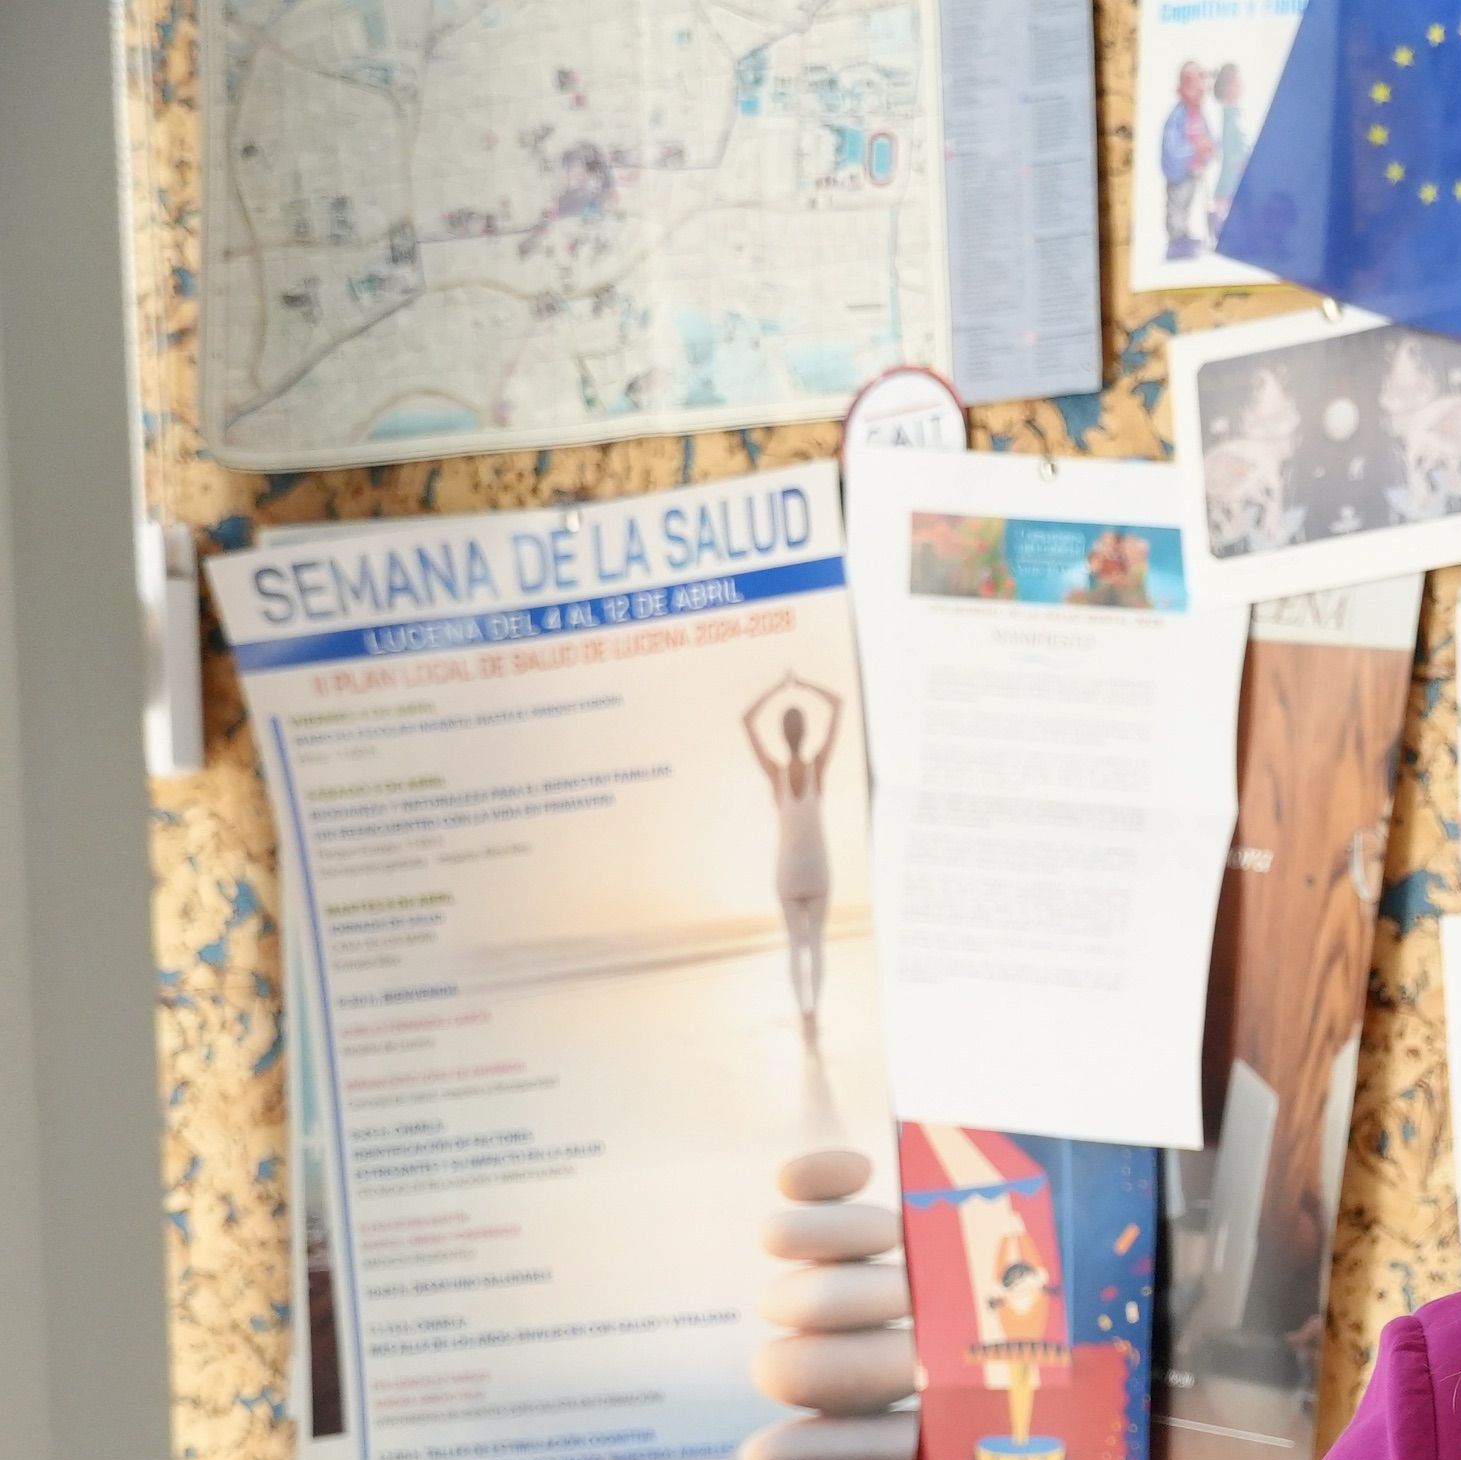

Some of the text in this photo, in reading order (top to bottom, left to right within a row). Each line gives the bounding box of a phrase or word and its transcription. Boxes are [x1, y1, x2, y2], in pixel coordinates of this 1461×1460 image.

[253, 487, 814, 626] SEMANA DE LA SALUD
[363, 617, 482, 657] LUCENA
[489, 611, 540, 643] DEL
[565, 601, 598, 630] AL
[605, 596, 630, 623] 12
[636, 589, 670, 619] DE
[676, 577, 744, 614] ABRIL
